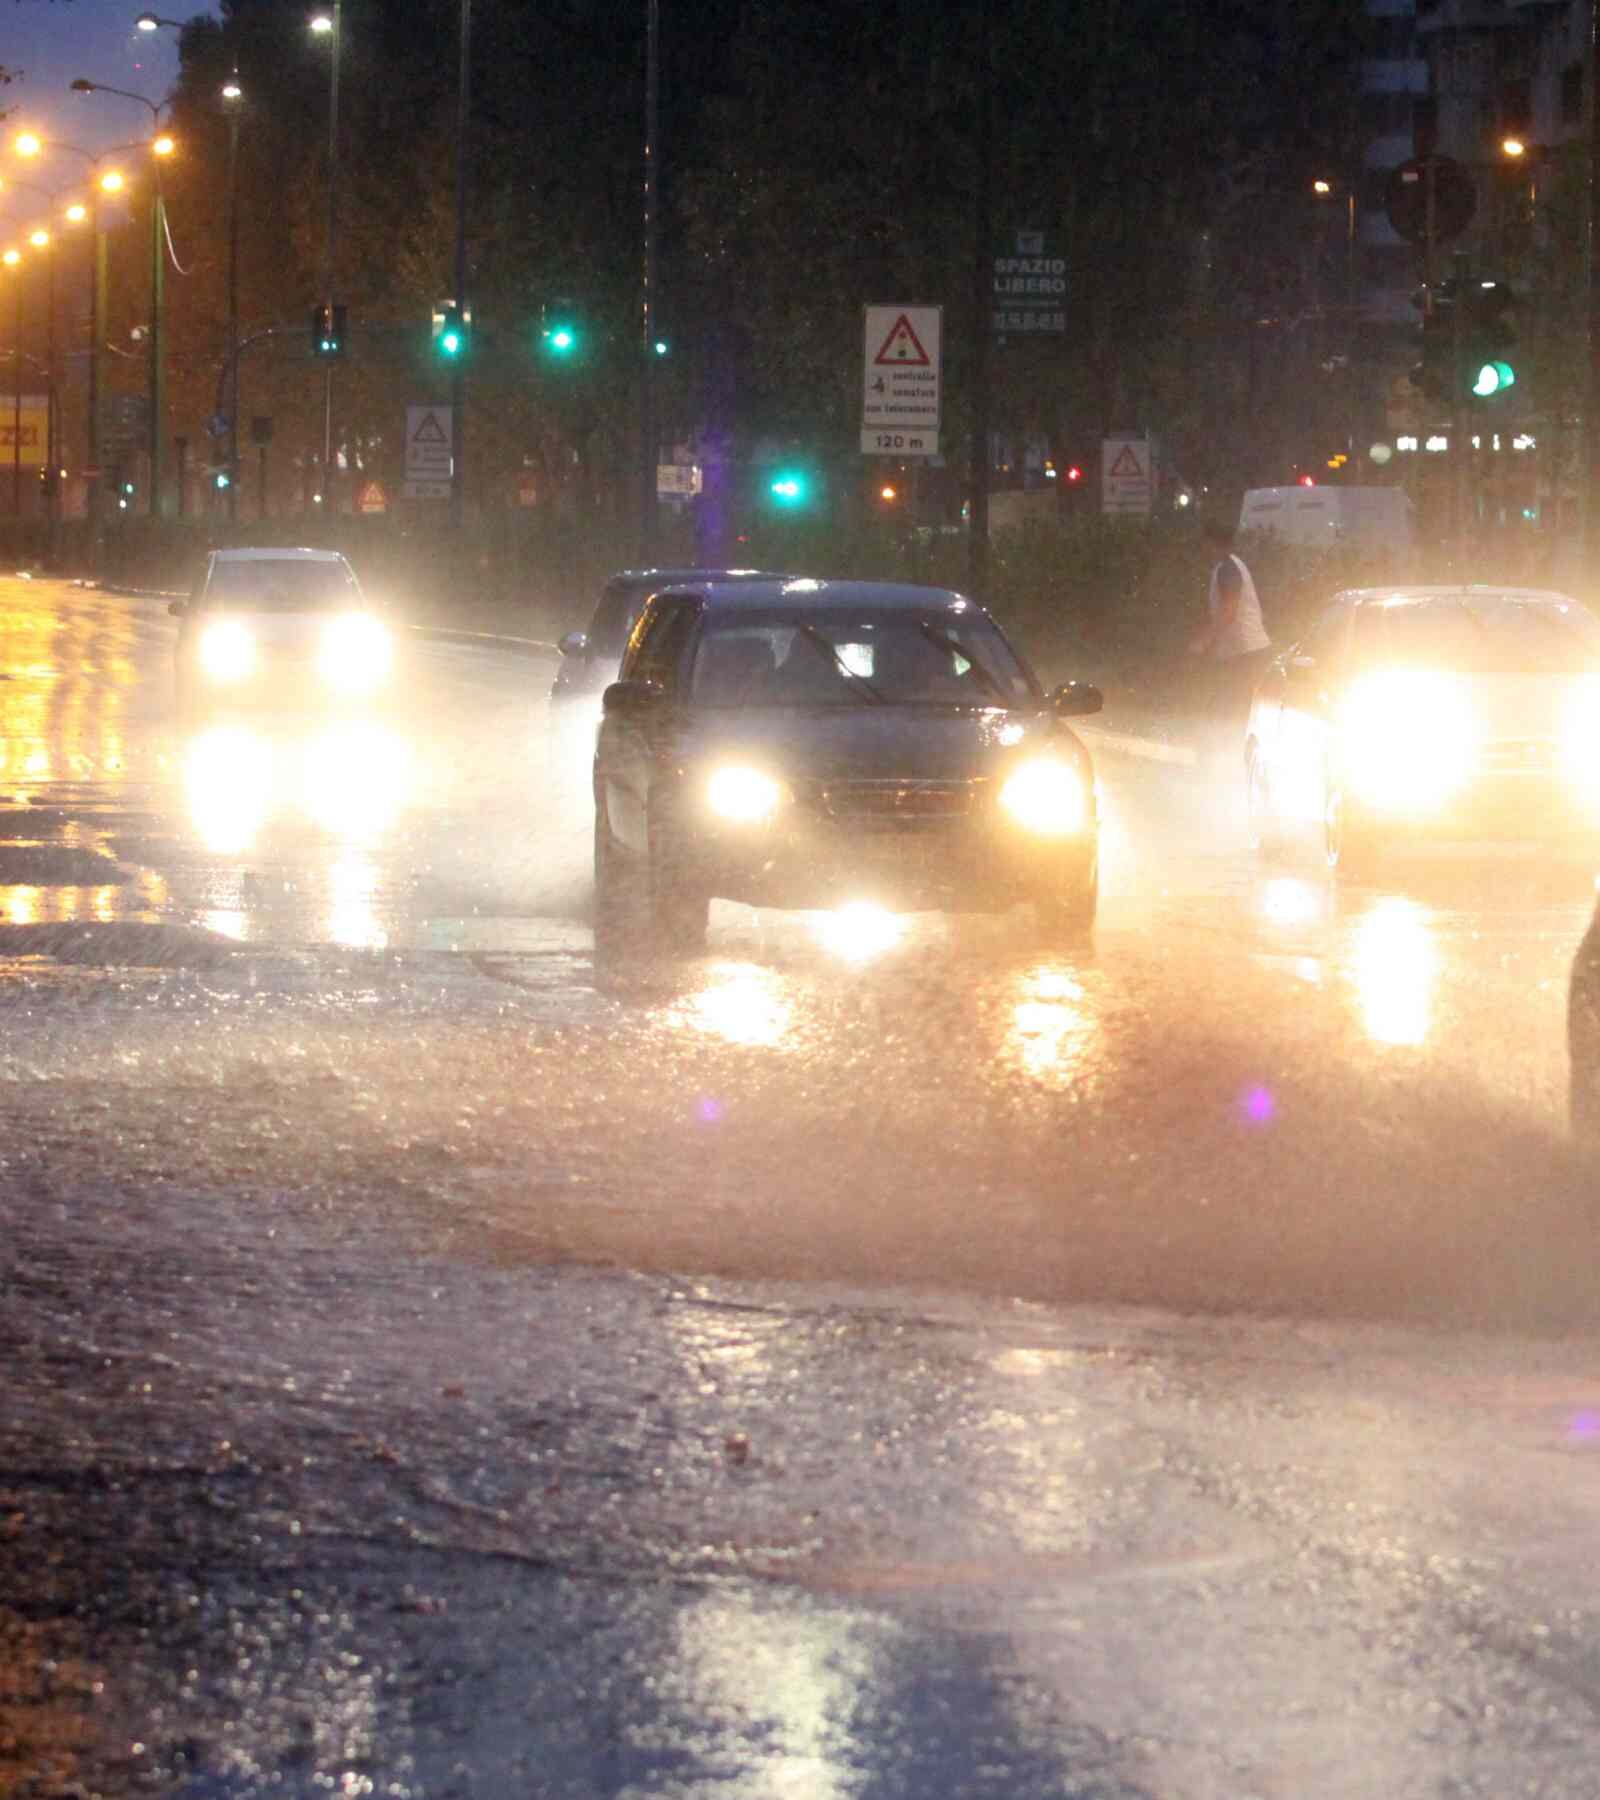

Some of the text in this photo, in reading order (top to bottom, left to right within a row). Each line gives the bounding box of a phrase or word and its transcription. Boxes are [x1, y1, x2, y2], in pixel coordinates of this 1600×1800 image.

[994, 258, 1065, 273] SPAZIO
[994, 278, 1065, 293] LIBERO
[877, 435, 924, 448] 120 m
